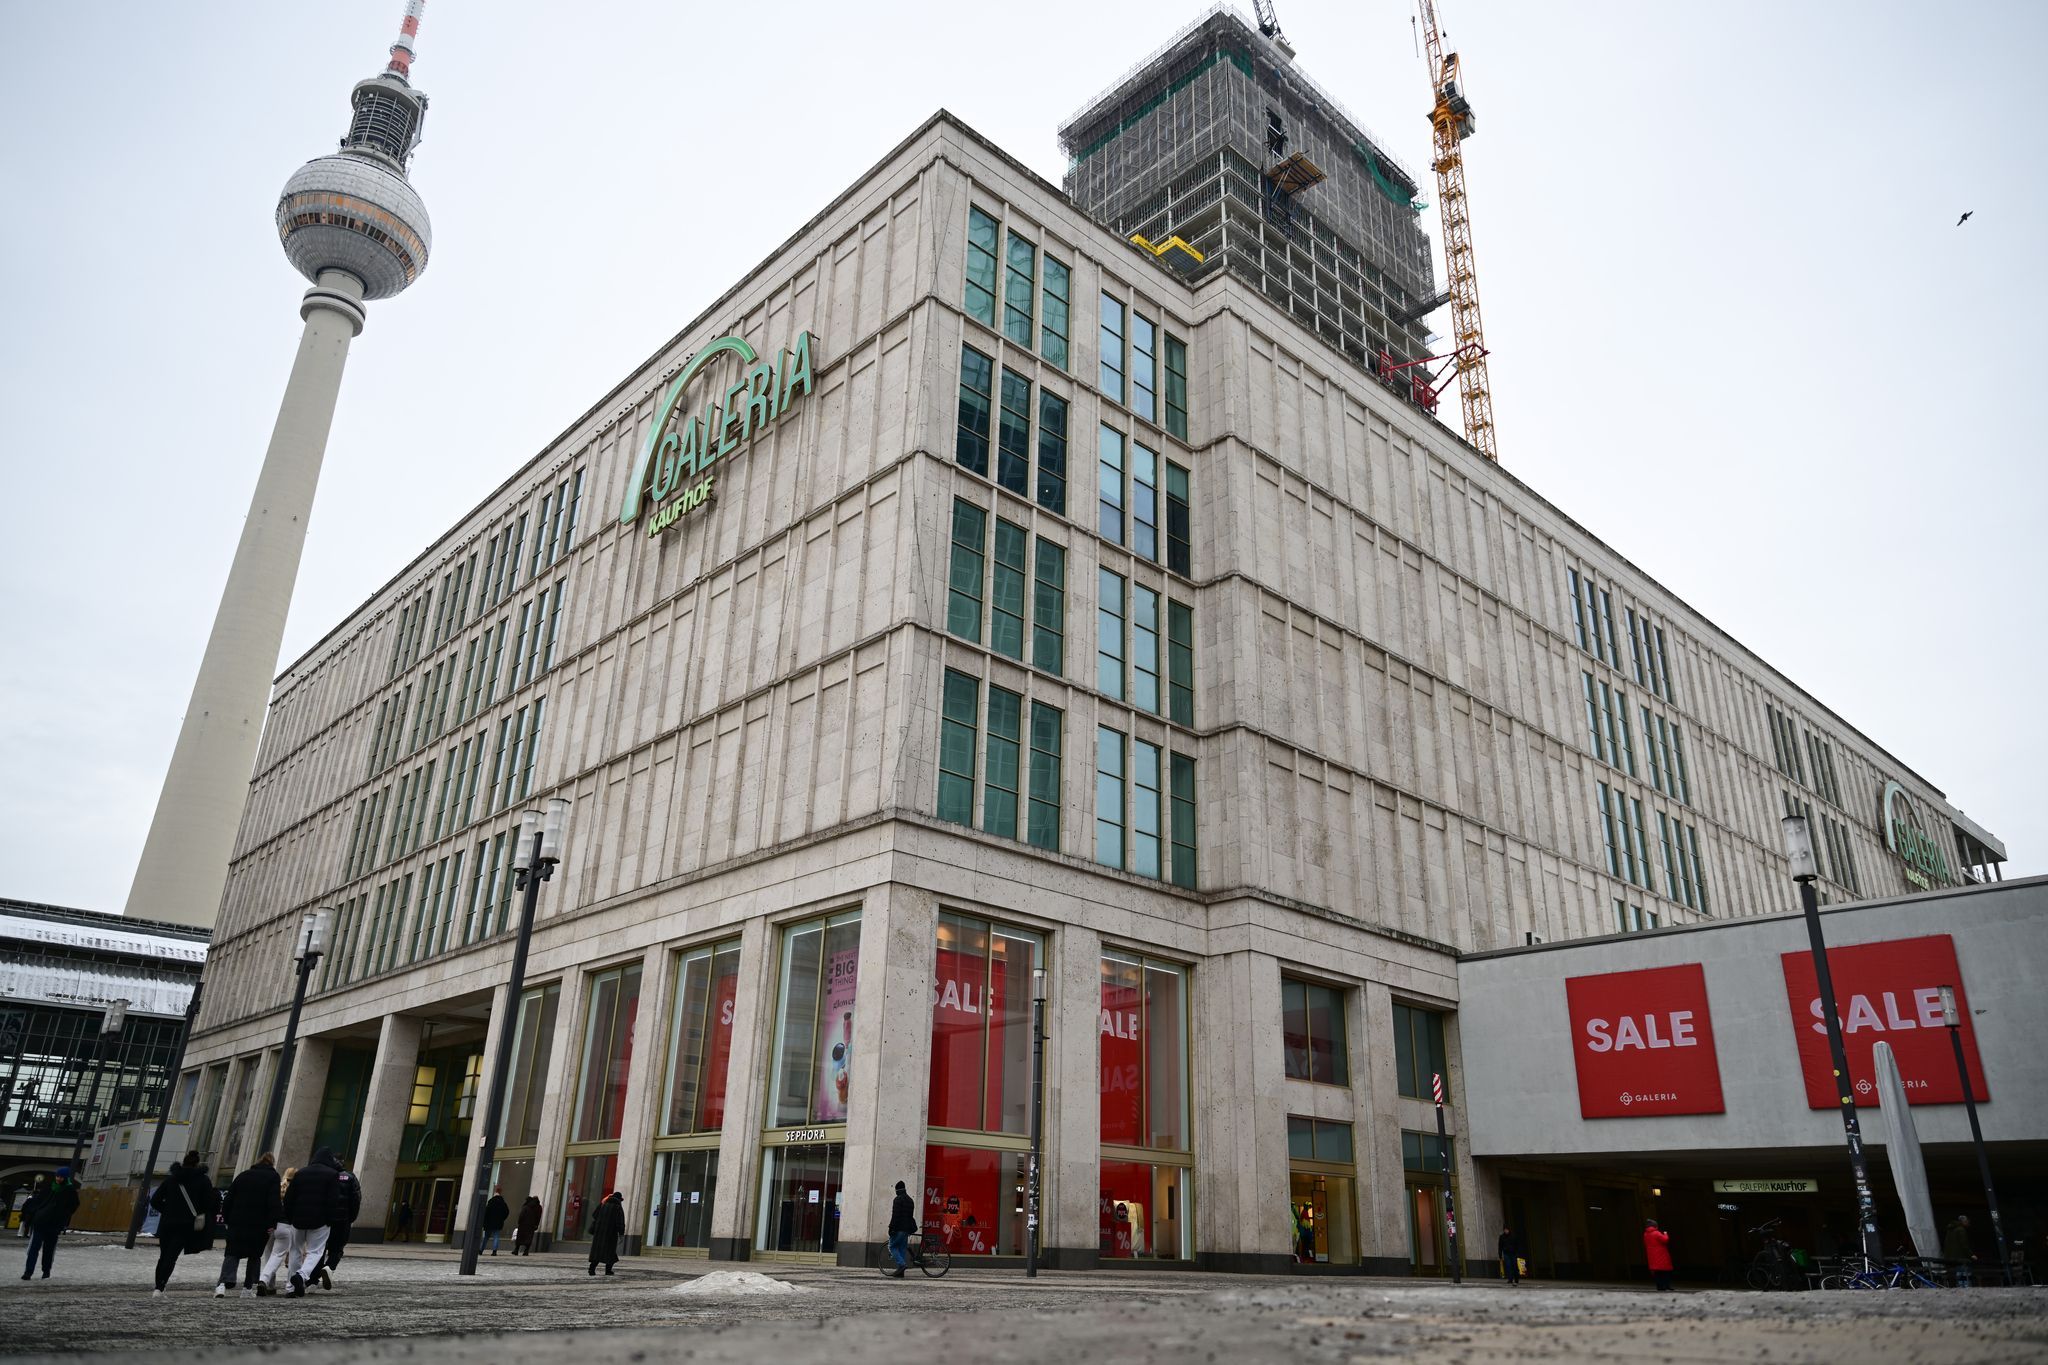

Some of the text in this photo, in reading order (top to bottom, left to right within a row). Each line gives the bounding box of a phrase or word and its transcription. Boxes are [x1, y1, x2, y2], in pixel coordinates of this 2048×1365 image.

[652, 331, 813, 501] GALERIA
[1895, 818, 1952, 888] GALERIA
[835, 959, 855, 977] BIG
[835, 975, 854, 986] THING
[1810, 987, 1946, 1036] SALE
[1586, 1010, 1698, 1053] SALE
[1635, 1093, 1678, 1102] GALERIA
[785, 1129, 826, 1142] SEPHORA
[1740, 1181, 1770, 1192] GALERIA
[924, 1220, 941, 1229] SALE
